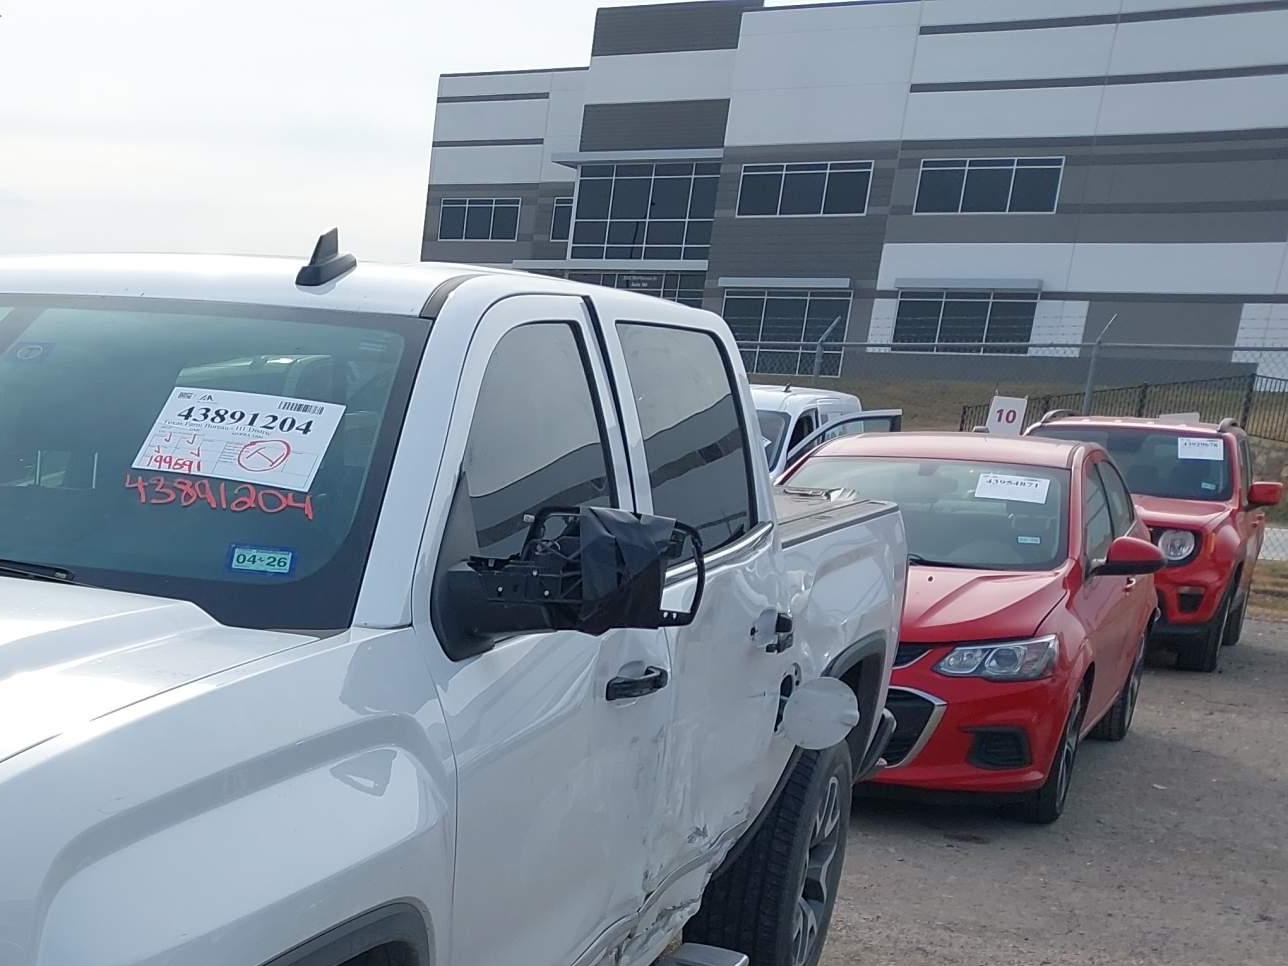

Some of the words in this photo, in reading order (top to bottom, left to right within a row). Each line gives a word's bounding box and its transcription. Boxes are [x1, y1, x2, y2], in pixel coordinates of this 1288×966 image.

[178, 406, 314, 435] 43891204
[996, 408, 1017, 424] 10
[124, 471, 314, 520] 43891204
